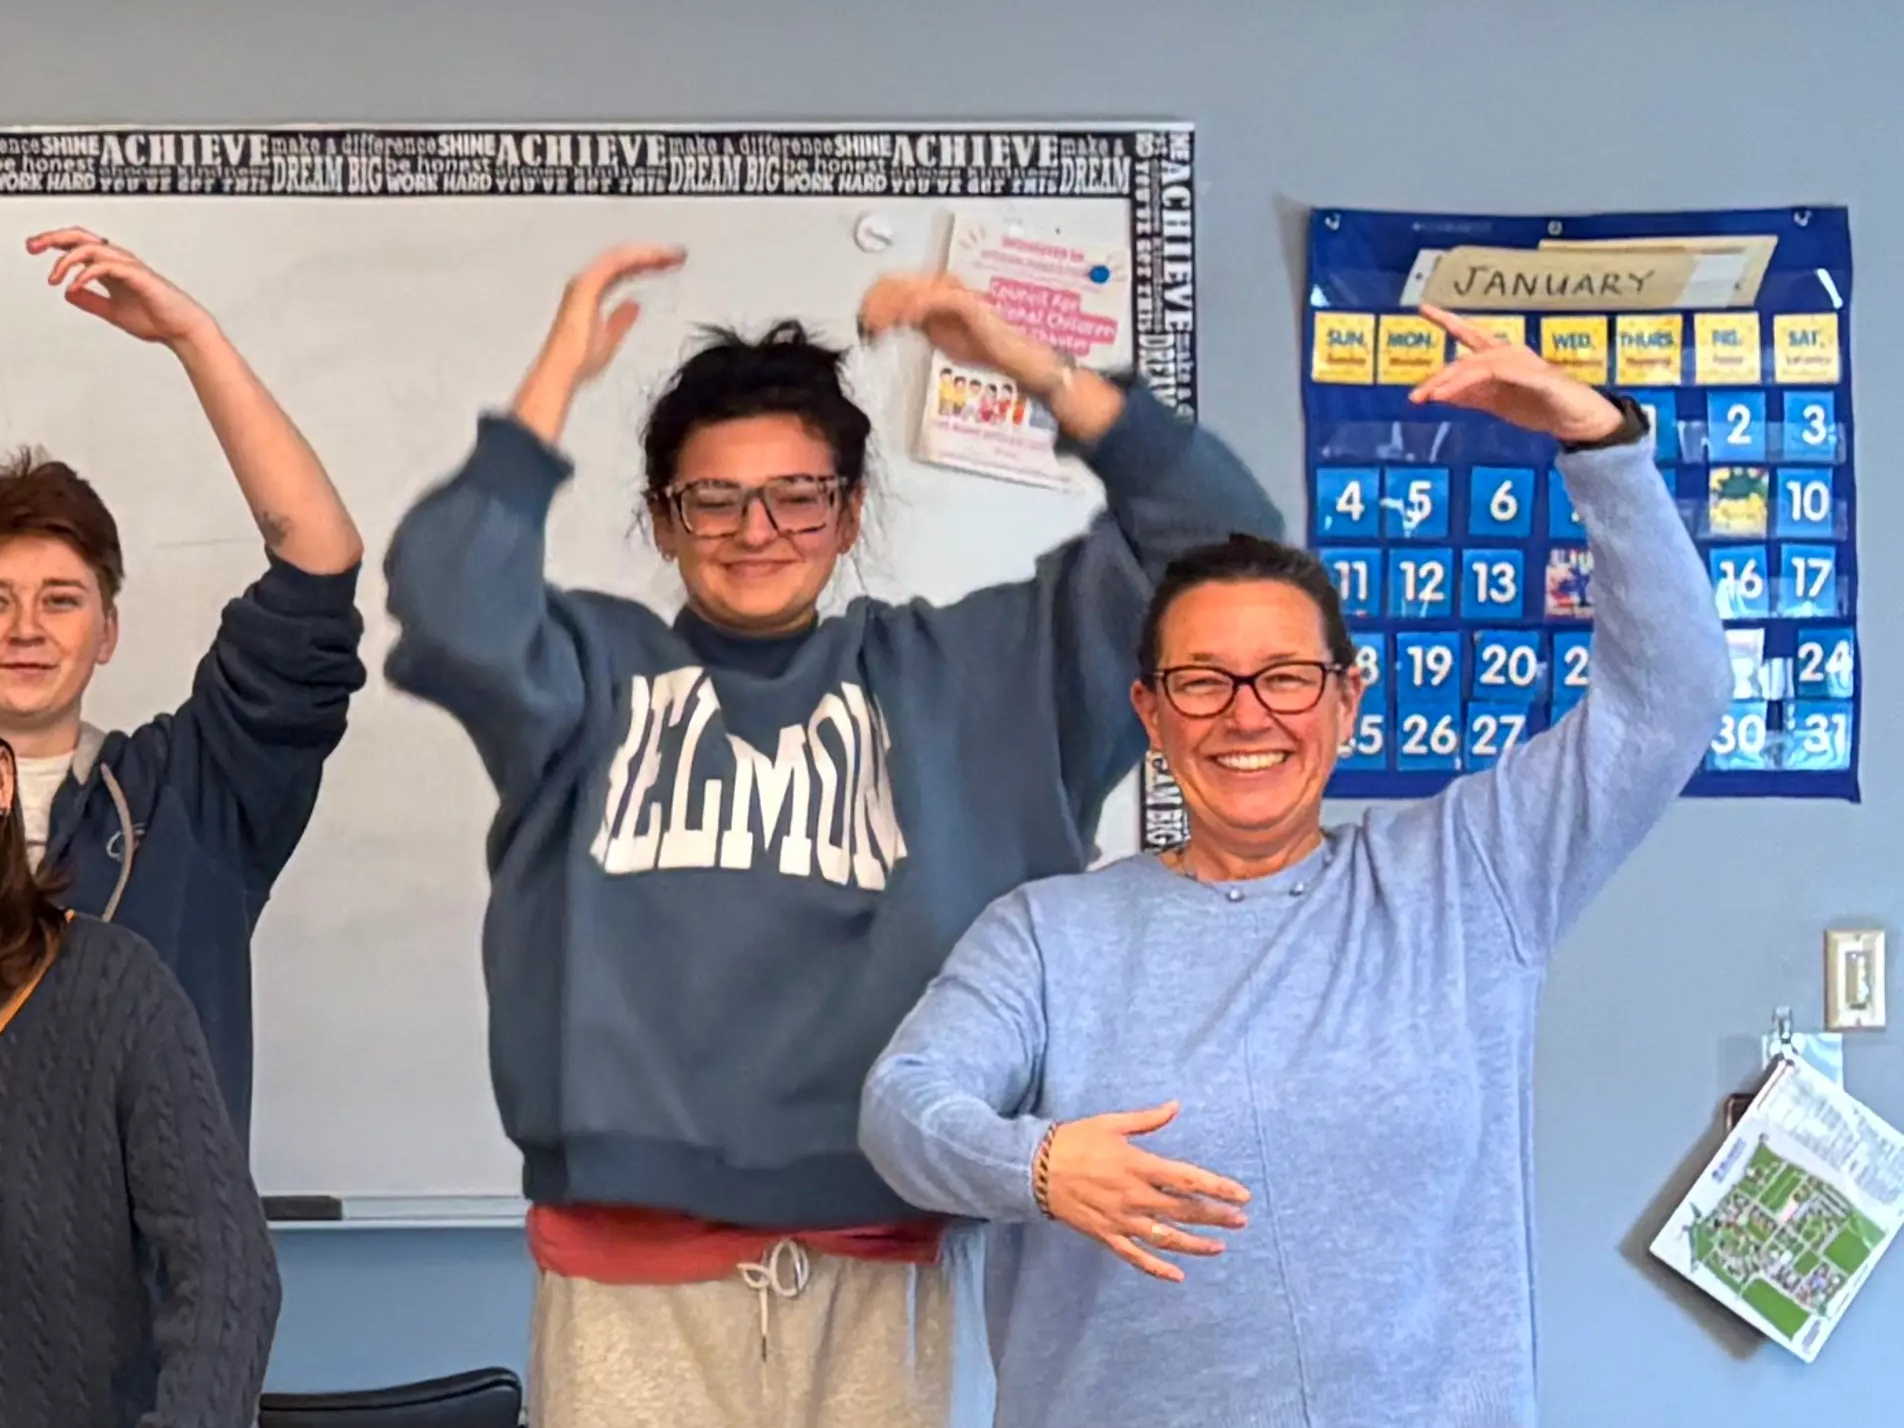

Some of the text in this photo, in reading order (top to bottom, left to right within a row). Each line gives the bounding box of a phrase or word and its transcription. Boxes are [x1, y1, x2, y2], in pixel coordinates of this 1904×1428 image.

[41, 135, 100, 156] SHINE
[100, 134, 270, 166] ACHIEVE
[438, 134, 496, 156] SHINE
[496, 134, 666, 167] ACHIEVE
[834, 134, 892, 157] SHINE
[892, 135, 1058, 167] ACHIEVE
[47, 172, 96, 191] HARD
[271, 156, 382, 193] DREAM BIG
[386, 173, 493, 192] WORK HARD
[668, 155, 780, 192] DREAM BIG
[783, 173, 888, 192] WORK HARD
[1060, 157, 1131, 194] DREAM
[1161, 160, 1193, 331] ACHIEVE
[1452, 264, 1655, 297] JANUARY
[1726, 403, 1752, 445] 2
[1801, 404, 1828, 445] 3
[1336, 480, 1830, 523] 4 5 6 10
[1333, 560, 1368, 601] 11
[1399, 560, 1445, 602] 12
[1472, 561, 1517, 603] 13
[1719, 558, 1763, 599] 16
[1792, 557, 1833, 598] 17
[1355, 640, 1854, 687] 8 19 20 2 24
[1401, 715, 1458, 755] 26
[1471, 715, 1526, 755] 27
[1803, 714, 1848, 754] 31
